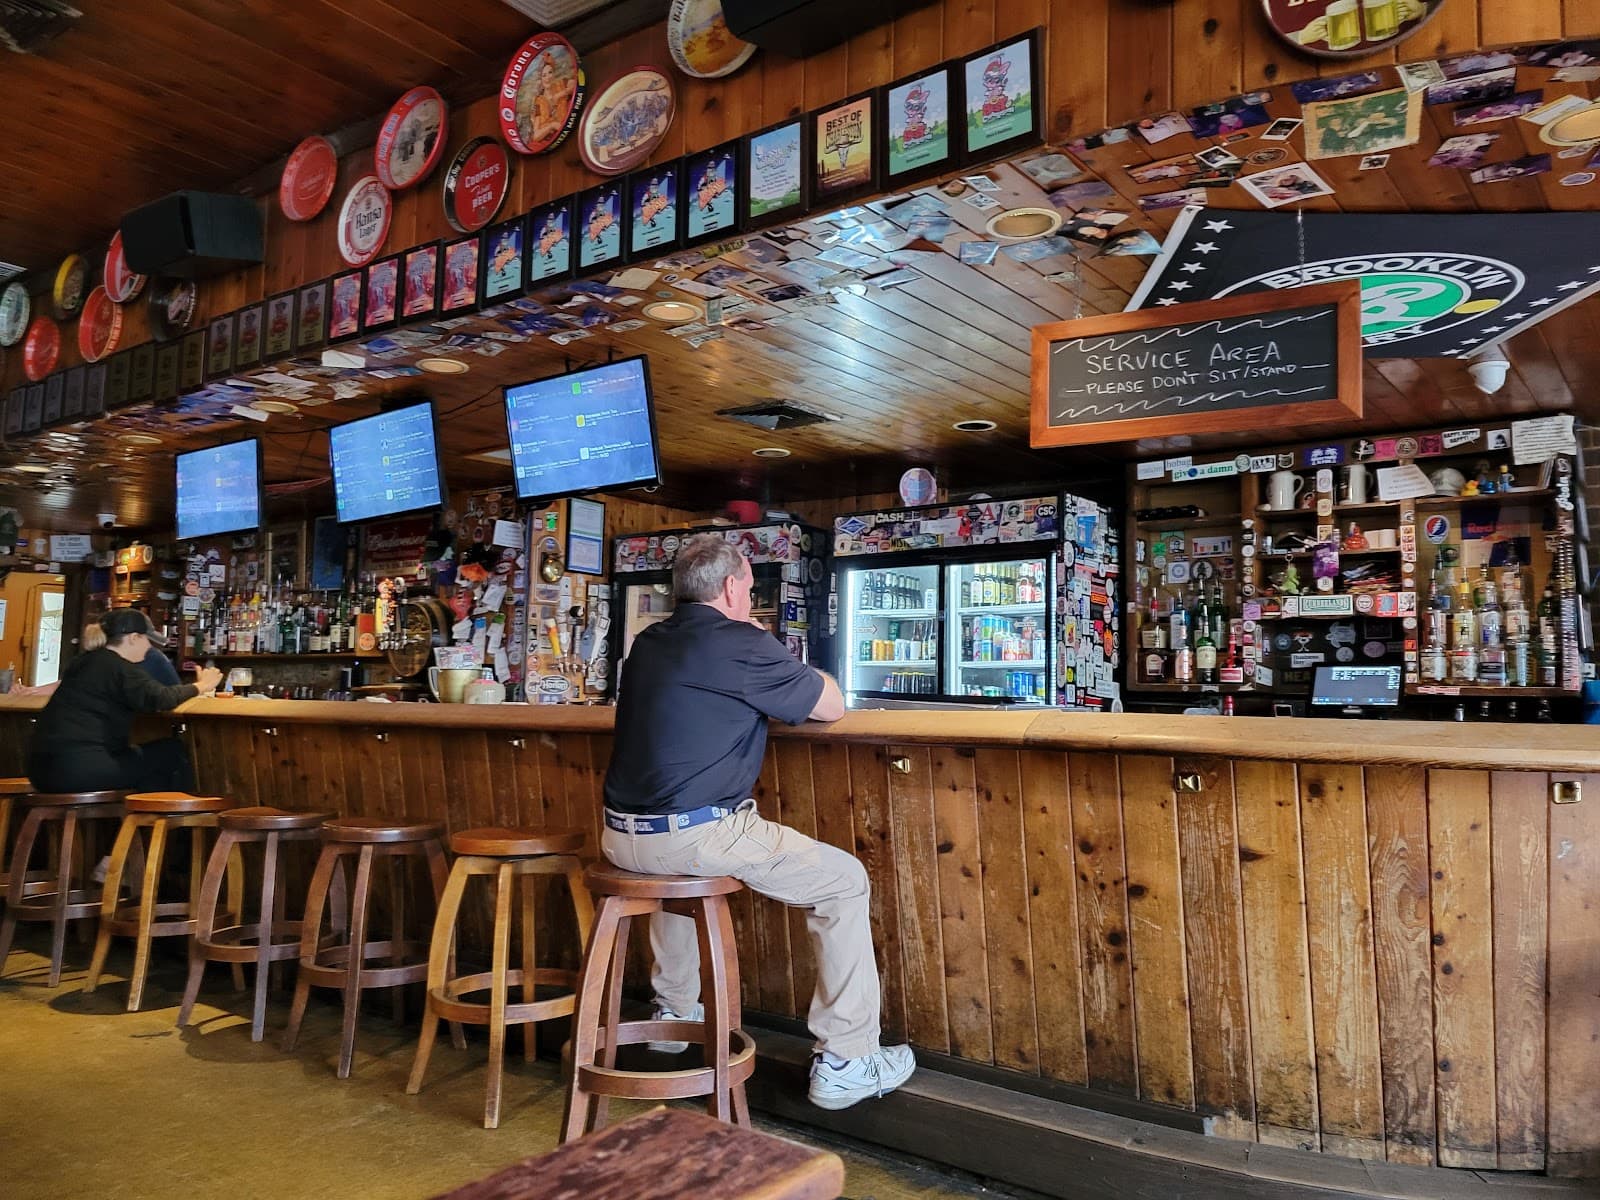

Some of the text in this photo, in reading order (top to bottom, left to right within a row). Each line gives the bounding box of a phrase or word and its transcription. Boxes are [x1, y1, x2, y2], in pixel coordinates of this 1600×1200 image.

[826, 110, 862, 132] BEST OF
[1260, 257, 1512, 290] BROOKLYN
[1086, 341, 1280, 374] SERVICE AREA
[1085, 380, 1145, 395] PLEASE
[875, 513, 904, 523] CASH
[1038, 506, 1054, 516] CSC
